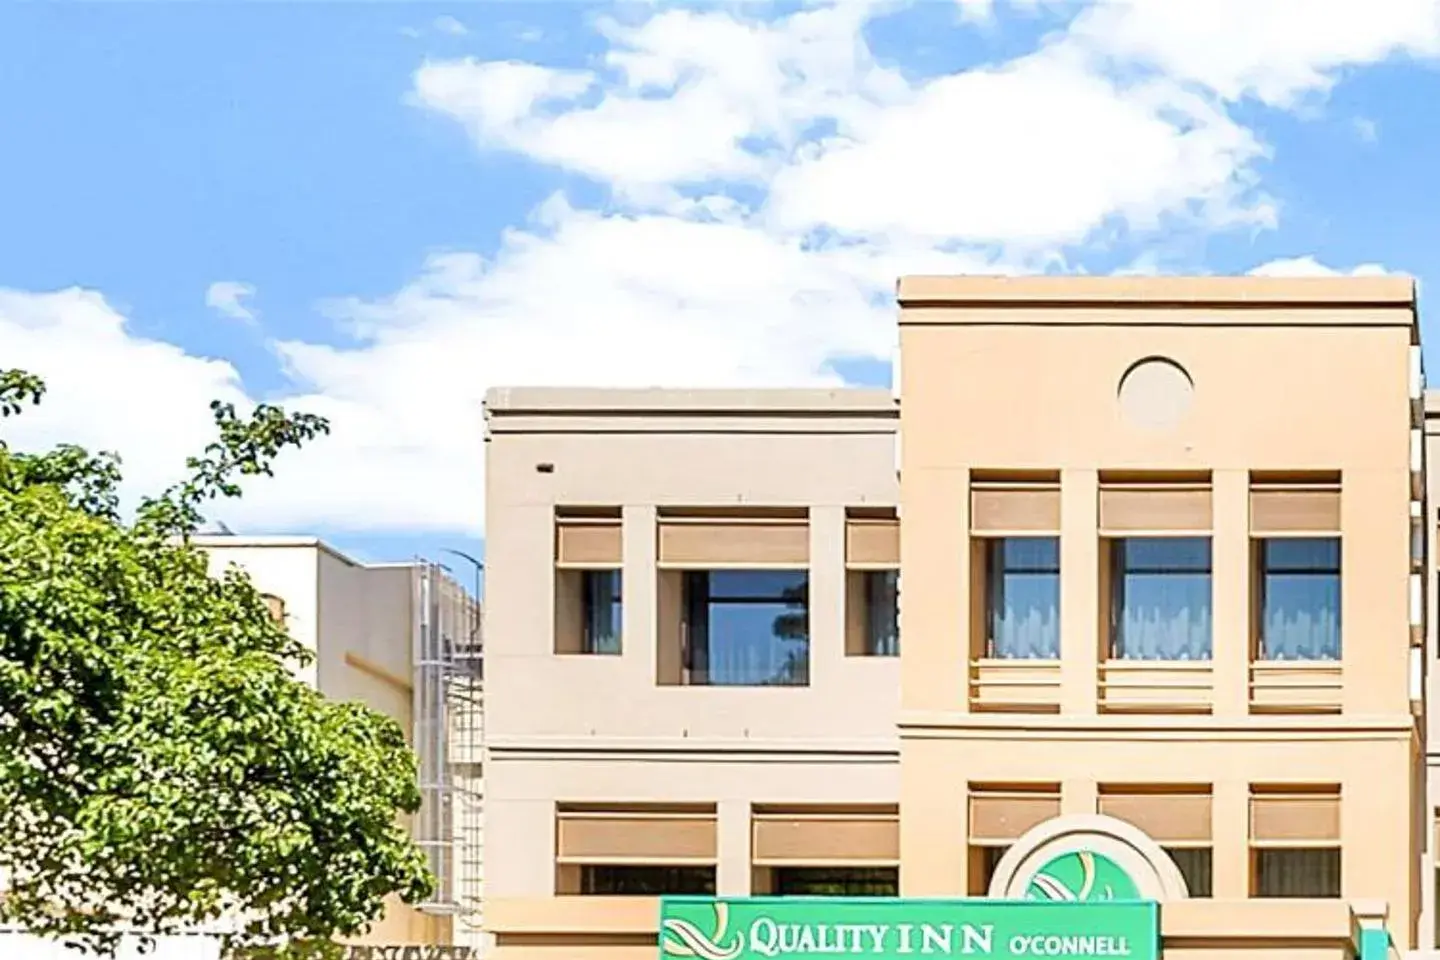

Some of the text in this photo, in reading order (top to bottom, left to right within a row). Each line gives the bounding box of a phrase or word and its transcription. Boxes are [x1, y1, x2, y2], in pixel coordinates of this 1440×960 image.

[750, 917, 1131, 957] QUALITY INN O'CONNELL
